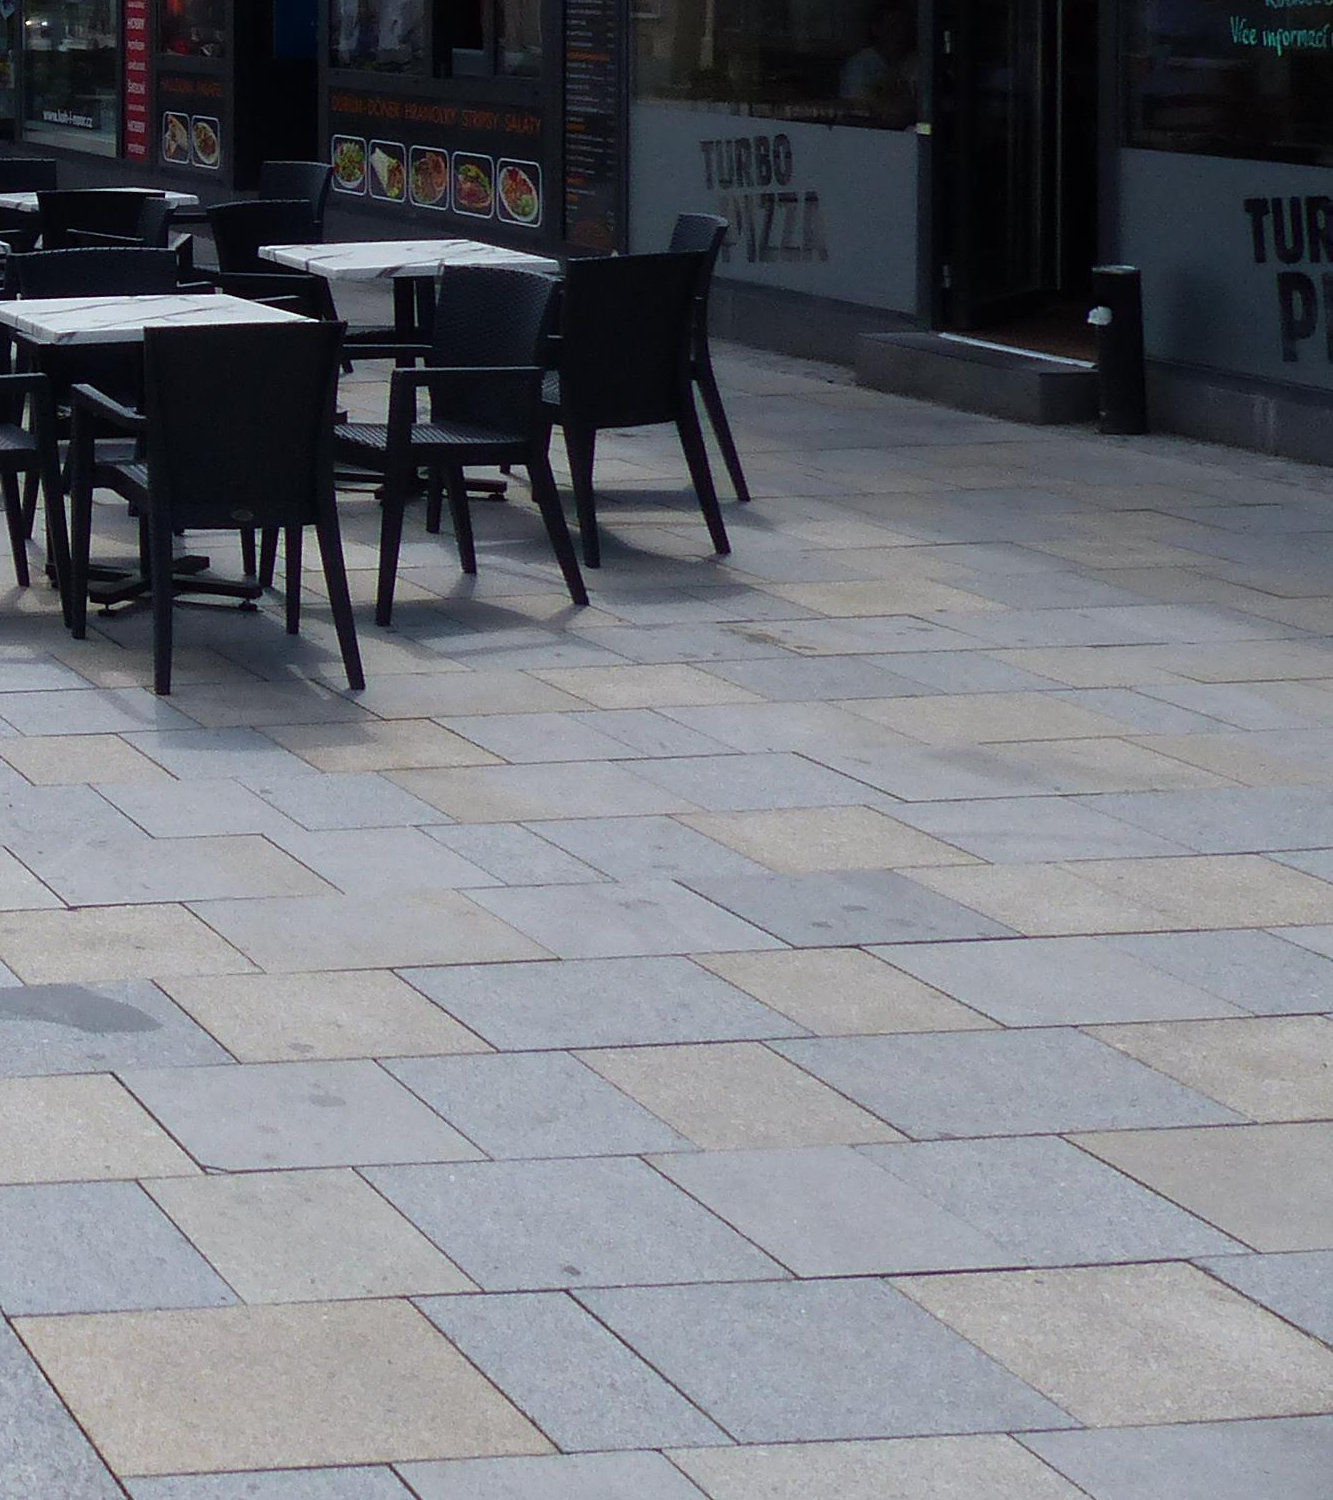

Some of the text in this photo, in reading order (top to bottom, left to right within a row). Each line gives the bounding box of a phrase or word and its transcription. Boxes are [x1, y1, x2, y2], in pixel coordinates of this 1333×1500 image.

[1230, 15, 1258, 45] Více
[699, 133, 792, 190] TURBO
[720, 190, 829, 263] PIZZA
[1244, 195, 1333, 263] TUR
[1277, 271, 1333, 363] PI
